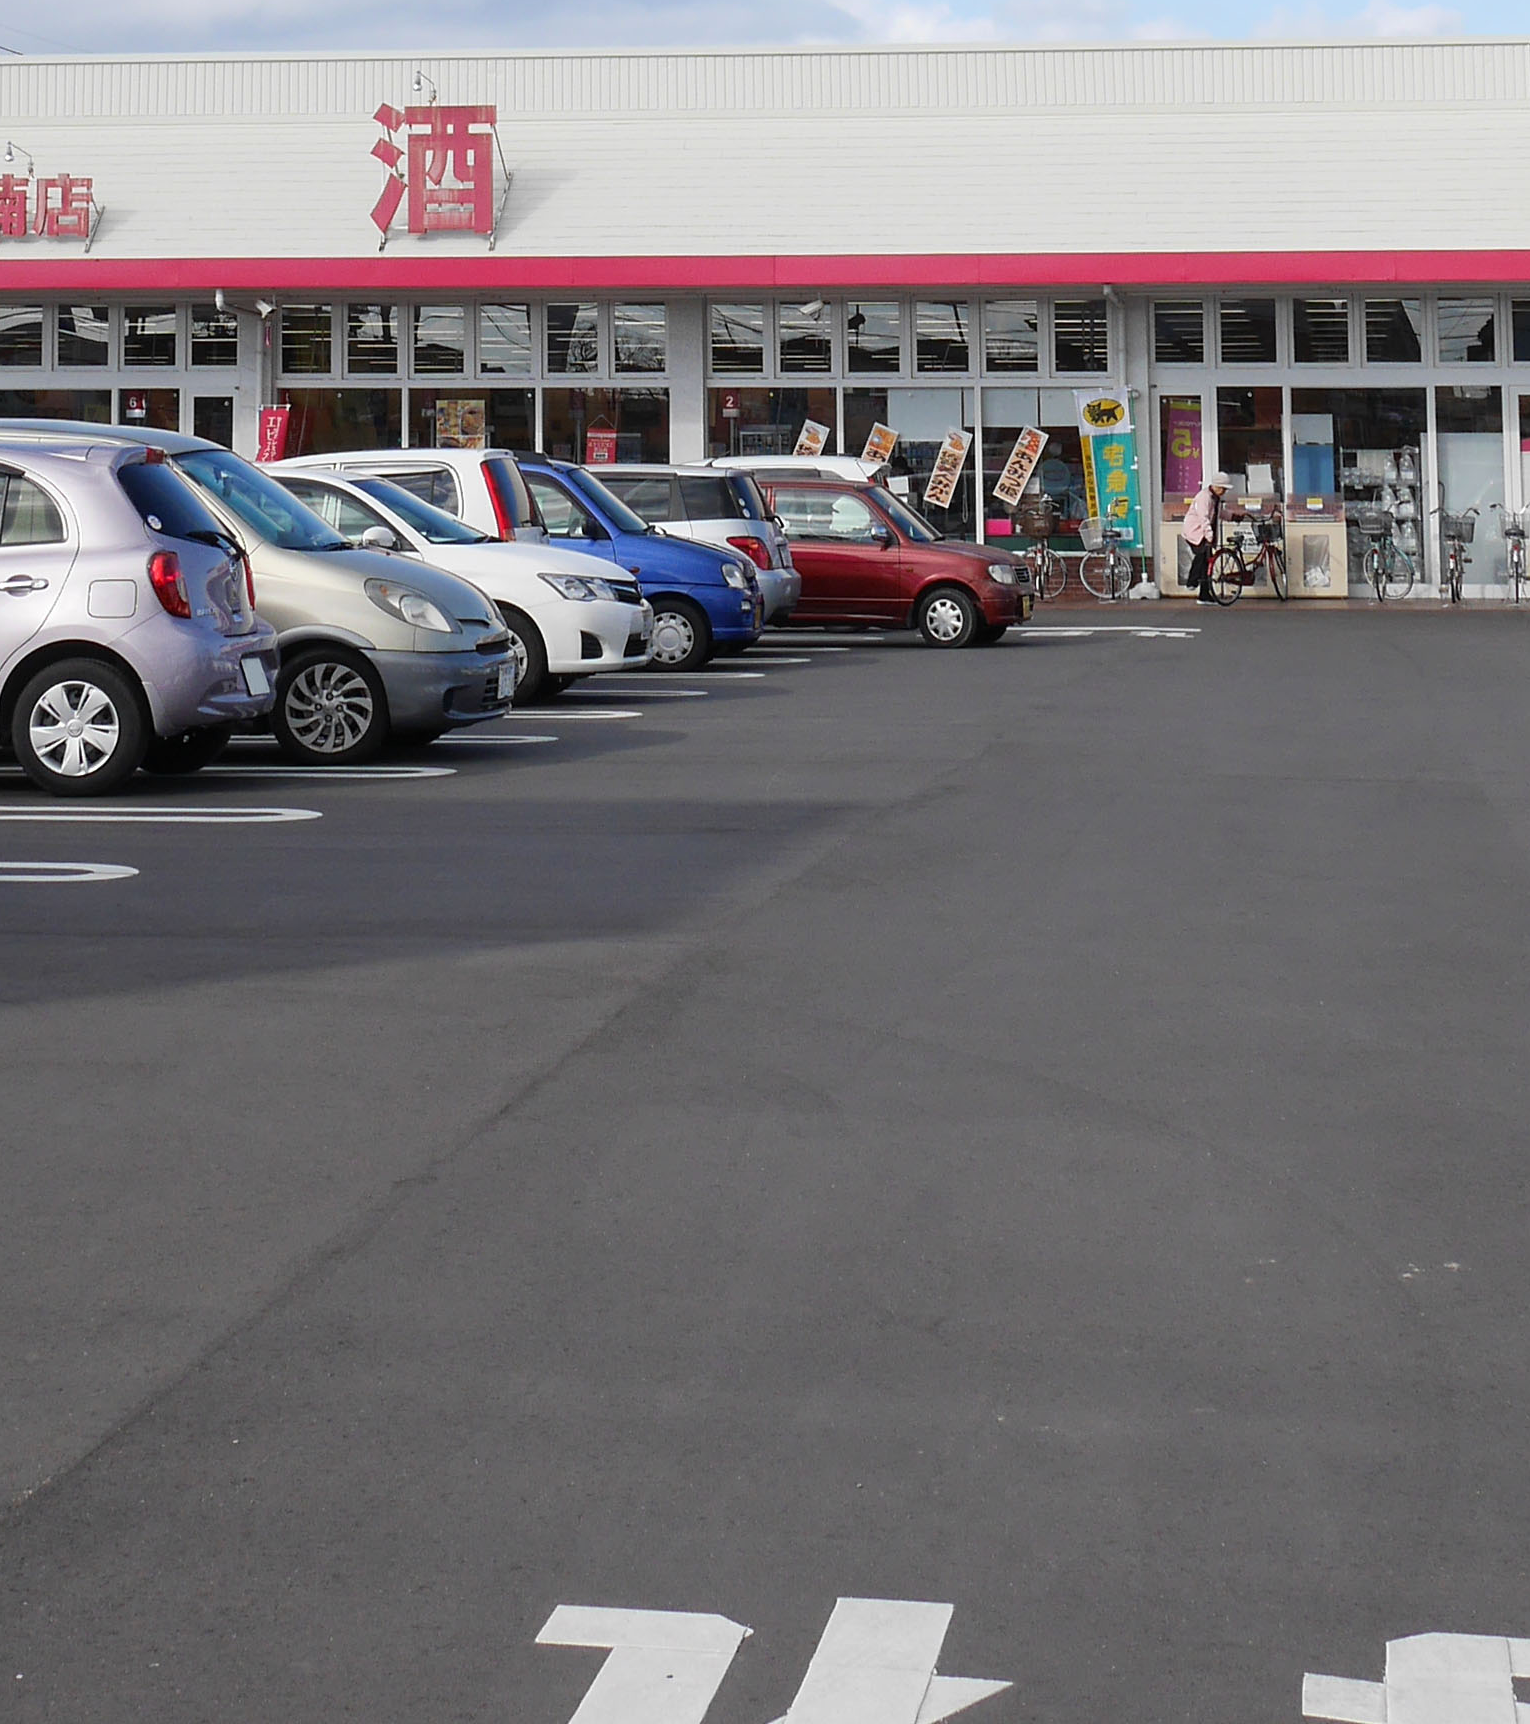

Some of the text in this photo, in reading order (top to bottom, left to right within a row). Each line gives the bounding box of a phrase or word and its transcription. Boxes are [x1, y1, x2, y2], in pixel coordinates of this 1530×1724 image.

[370, 103, 497, 235] 酒
[128, 396, 138, 409] 6
[725, 395, 735, 408] 2
